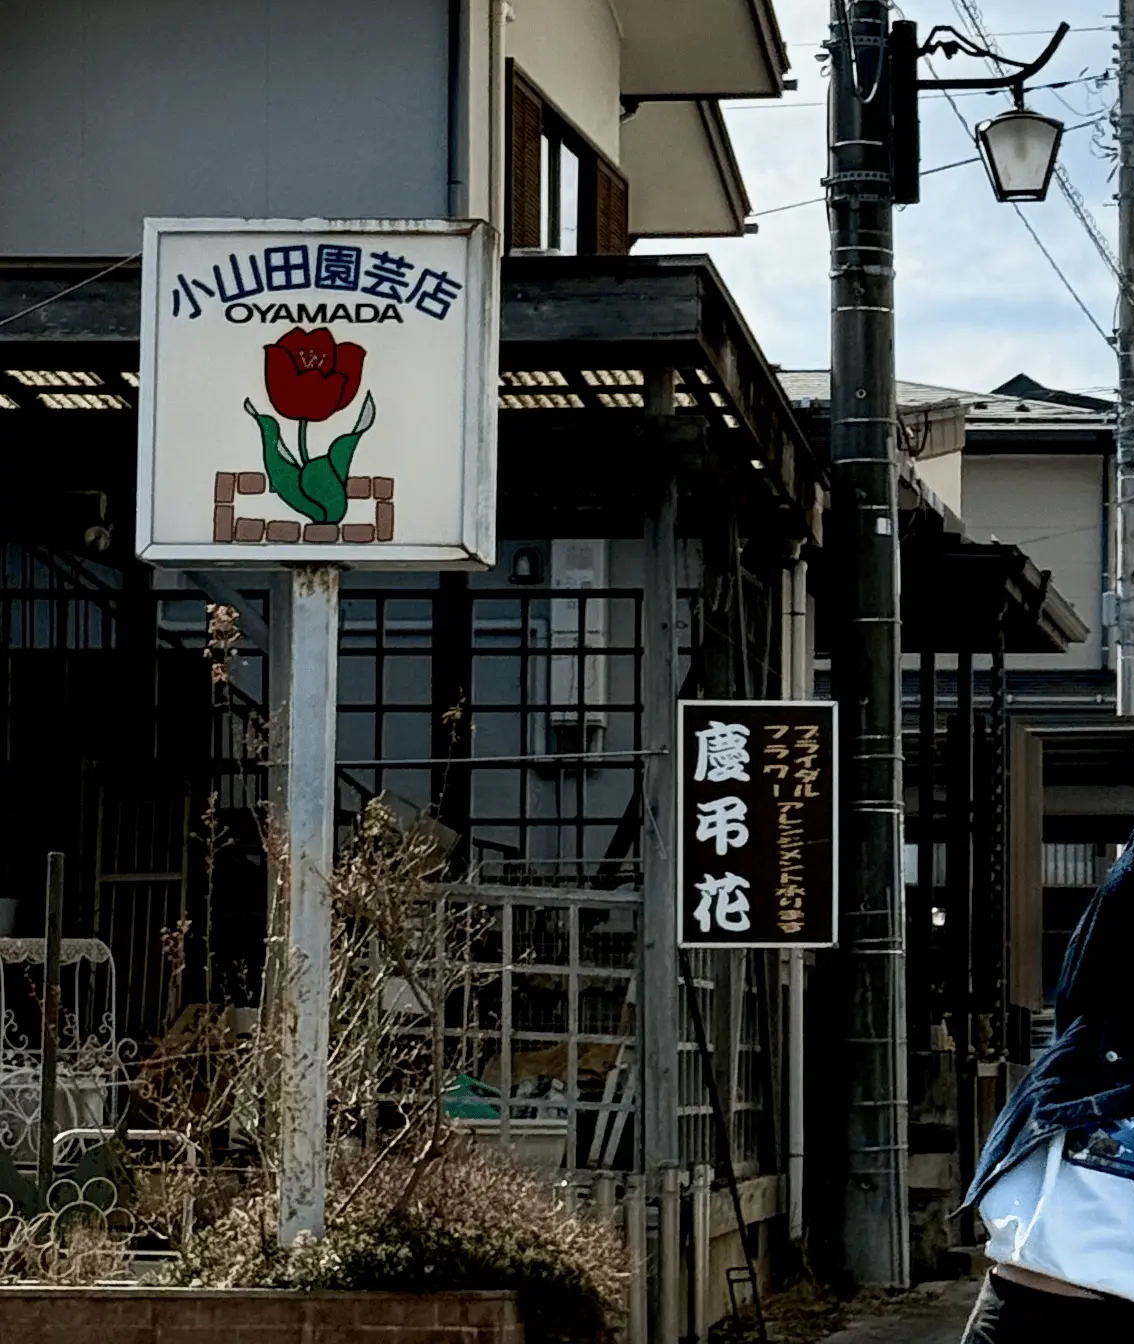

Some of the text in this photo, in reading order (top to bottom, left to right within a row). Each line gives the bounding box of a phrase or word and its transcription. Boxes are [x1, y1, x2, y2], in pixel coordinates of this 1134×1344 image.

[172, 244, 463, 321] 小山田園芸店
[225, 303, 404, 324] OYAMADA
[763, 725, 789, 798] フラワー
[694, 720, 750, 933] 慶弔花
